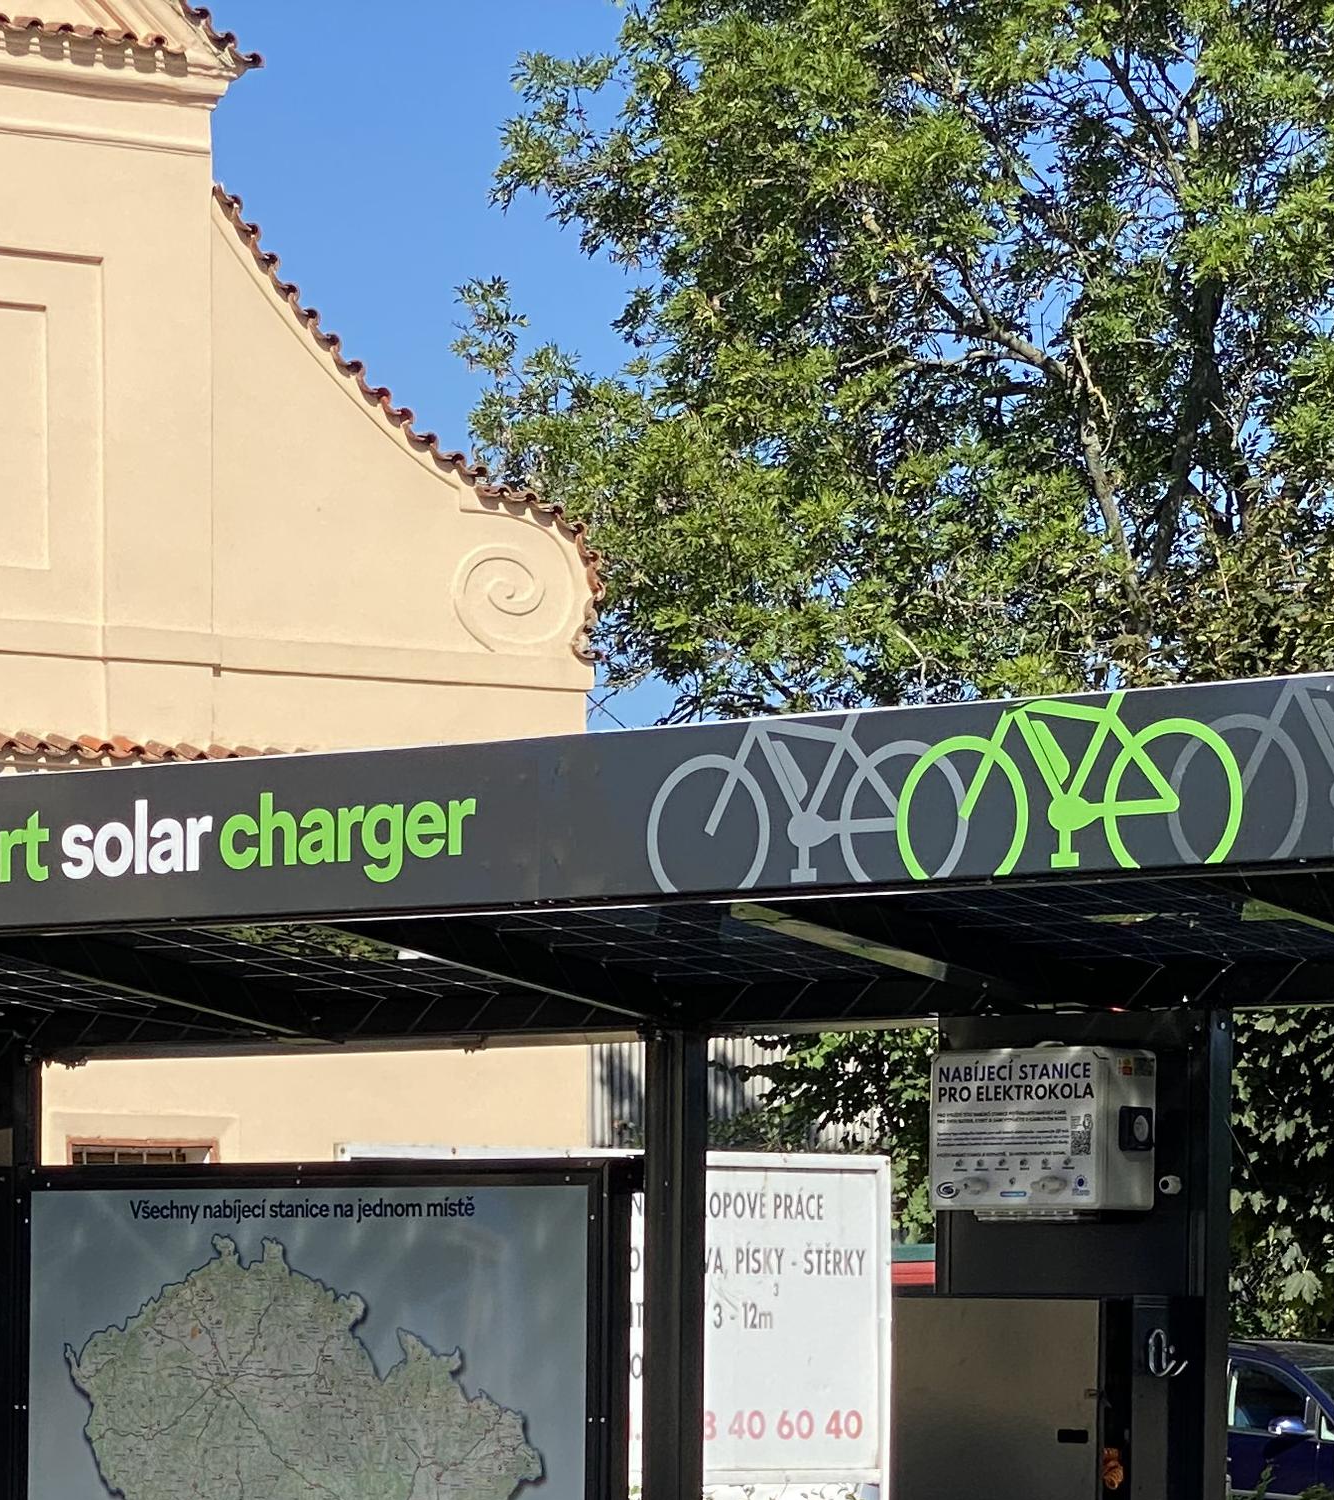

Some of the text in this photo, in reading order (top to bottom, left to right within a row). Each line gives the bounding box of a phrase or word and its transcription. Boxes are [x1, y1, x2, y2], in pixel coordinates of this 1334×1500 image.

[61, 799, 213, 878] solar
[219, 792, 477, 883] charger
[938, 1058, 1013, 1083] NABÍJECÍ
[1019, 1062, 1091, 1081] STANICE
[938, 1082, 1095, 1103] PRO ELEKTROKOLA
[129, 1196, 476, 1224] Všechny nabíjecí stanice na jednom místě
[705, 1186, 824, 1220] OPOVÉ PRÁCE
[735, 1241, 785, 1275] PÍSKY
[804, 1242, 866, 1276] ŠTĚRKY
[728, 1409, 766, 1440] 40
[776, 1409, 815, 1441] 60
[825, 1409, 863, 1440] 40
